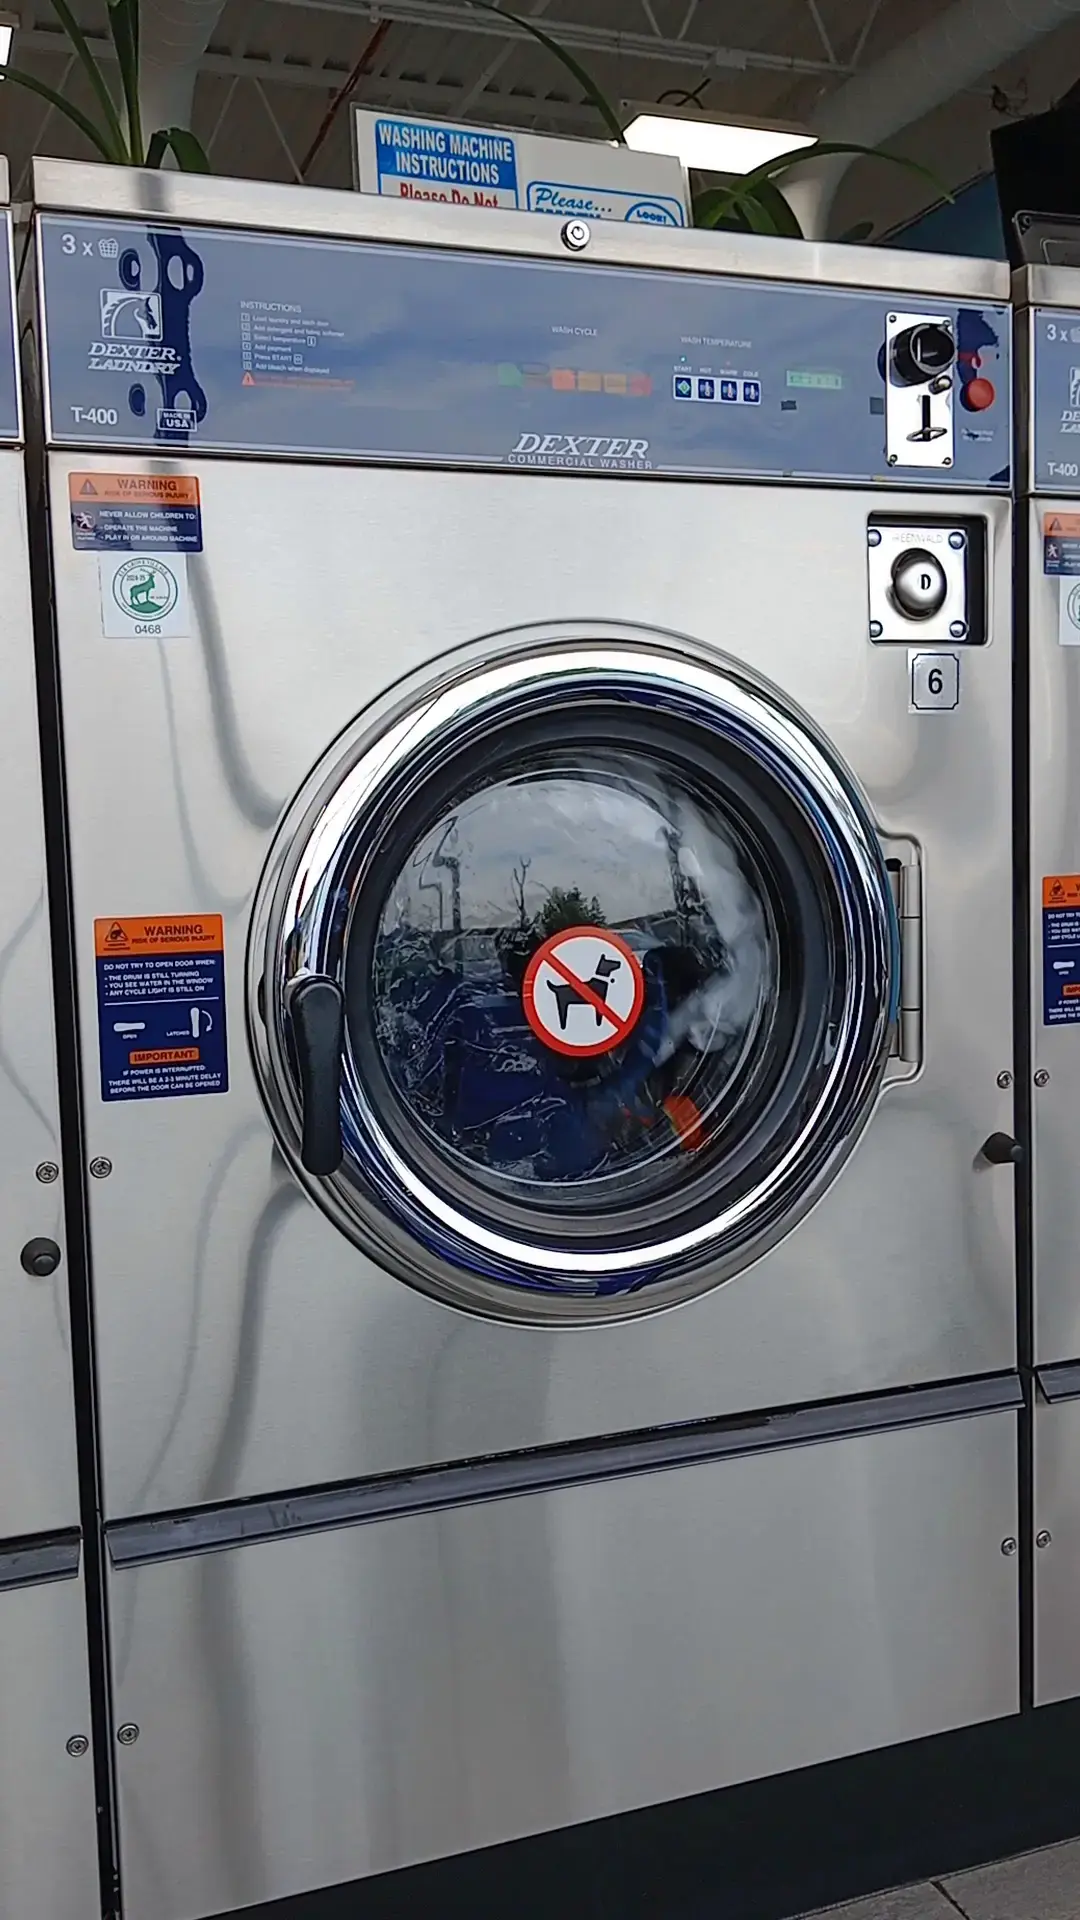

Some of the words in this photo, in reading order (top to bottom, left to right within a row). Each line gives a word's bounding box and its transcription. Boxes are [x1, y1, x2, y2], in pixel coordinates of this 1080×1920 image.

[379, 123, 446, 153] WASHING
[450, 134, 512, 162] MACHINE
[396, 151, 500, 184] INSTRUCTIONS
[636, 210, 667, 224] LOOK!
[61, 234, 76, 254] 3
[82, 242, 94, 256] x
[240, 301, 301, 313] INSTRUCTIONS
[551, 325, 573, 334] WASH
[574, 327, 597, 336] CYCLE
[1047, 324, 1057, 341] 3
[1060, 330, 1068, 341] x
[680, 336, 701, 344] WASH
[703, 337, 752, 348] TEMPERATURE
[88, 342, 176, 361] DEXTER
[88, 358, 180, 374] LAUNDRY
[71, 406, 117, 424] T-400
[166, 419, 189, 428] USA
[511, 433, 649, 459] DEXTER
[508, 453, 594, 468] COMMERCIAL
[600, 459, 652, 470] WASHER
[1047, 462, 1078, 477] T-400
[117, 479, 177, 491] WARNING
[920, 574, 931, 590] D
[135, 625, 162, 635] 0468
[928, 668, 943, 695] 6
[144, 924, 203, 936] WARNING
[124, 988, 146, 996] CYCLE
[134, 1050, 194, 1062] IMPORTANT
[132, 1077, 147, 1085] WILL
[175, 1074, 199, 1082] MINUTE
[110, 1086, 136, 1094] BEFORE
